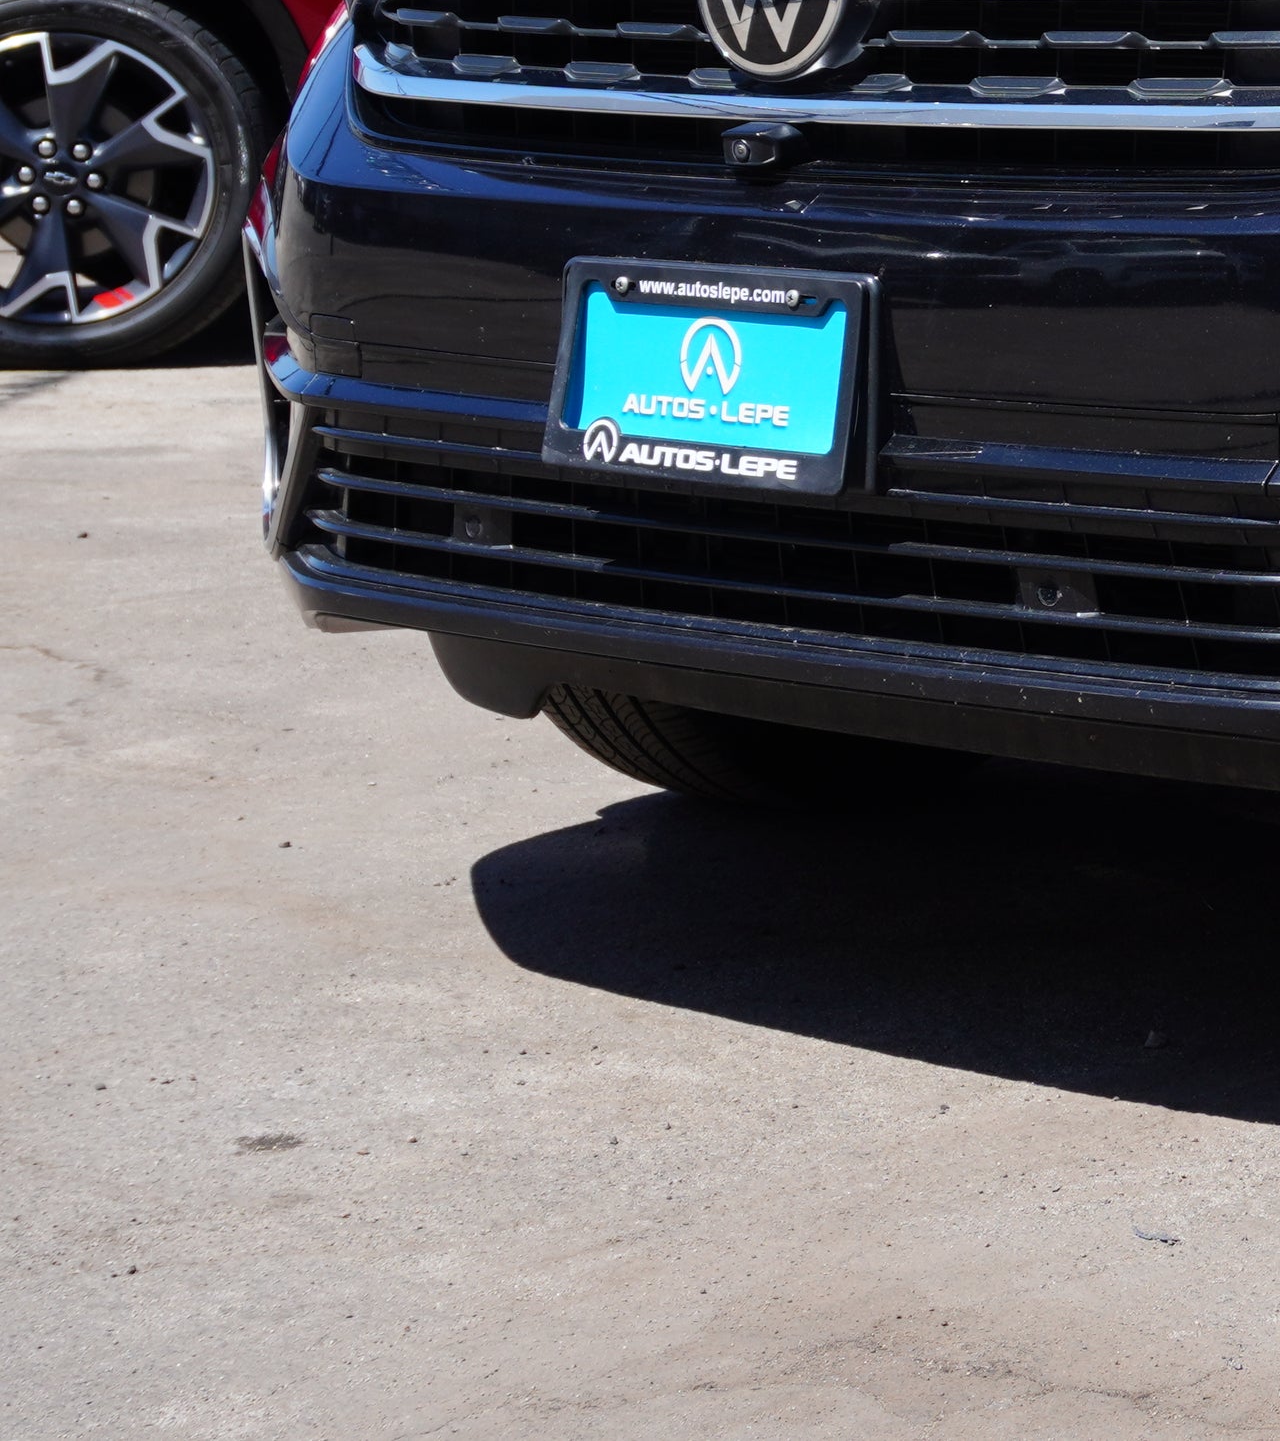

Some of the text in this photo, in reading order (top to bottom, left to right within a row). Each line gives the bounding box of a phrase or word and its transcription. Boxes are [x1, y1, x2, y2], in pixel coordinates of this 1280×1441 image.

[639, 279, 785, 304] www.autoslepe.com
[622, 393, 790, 427] AUTOS LEPE
